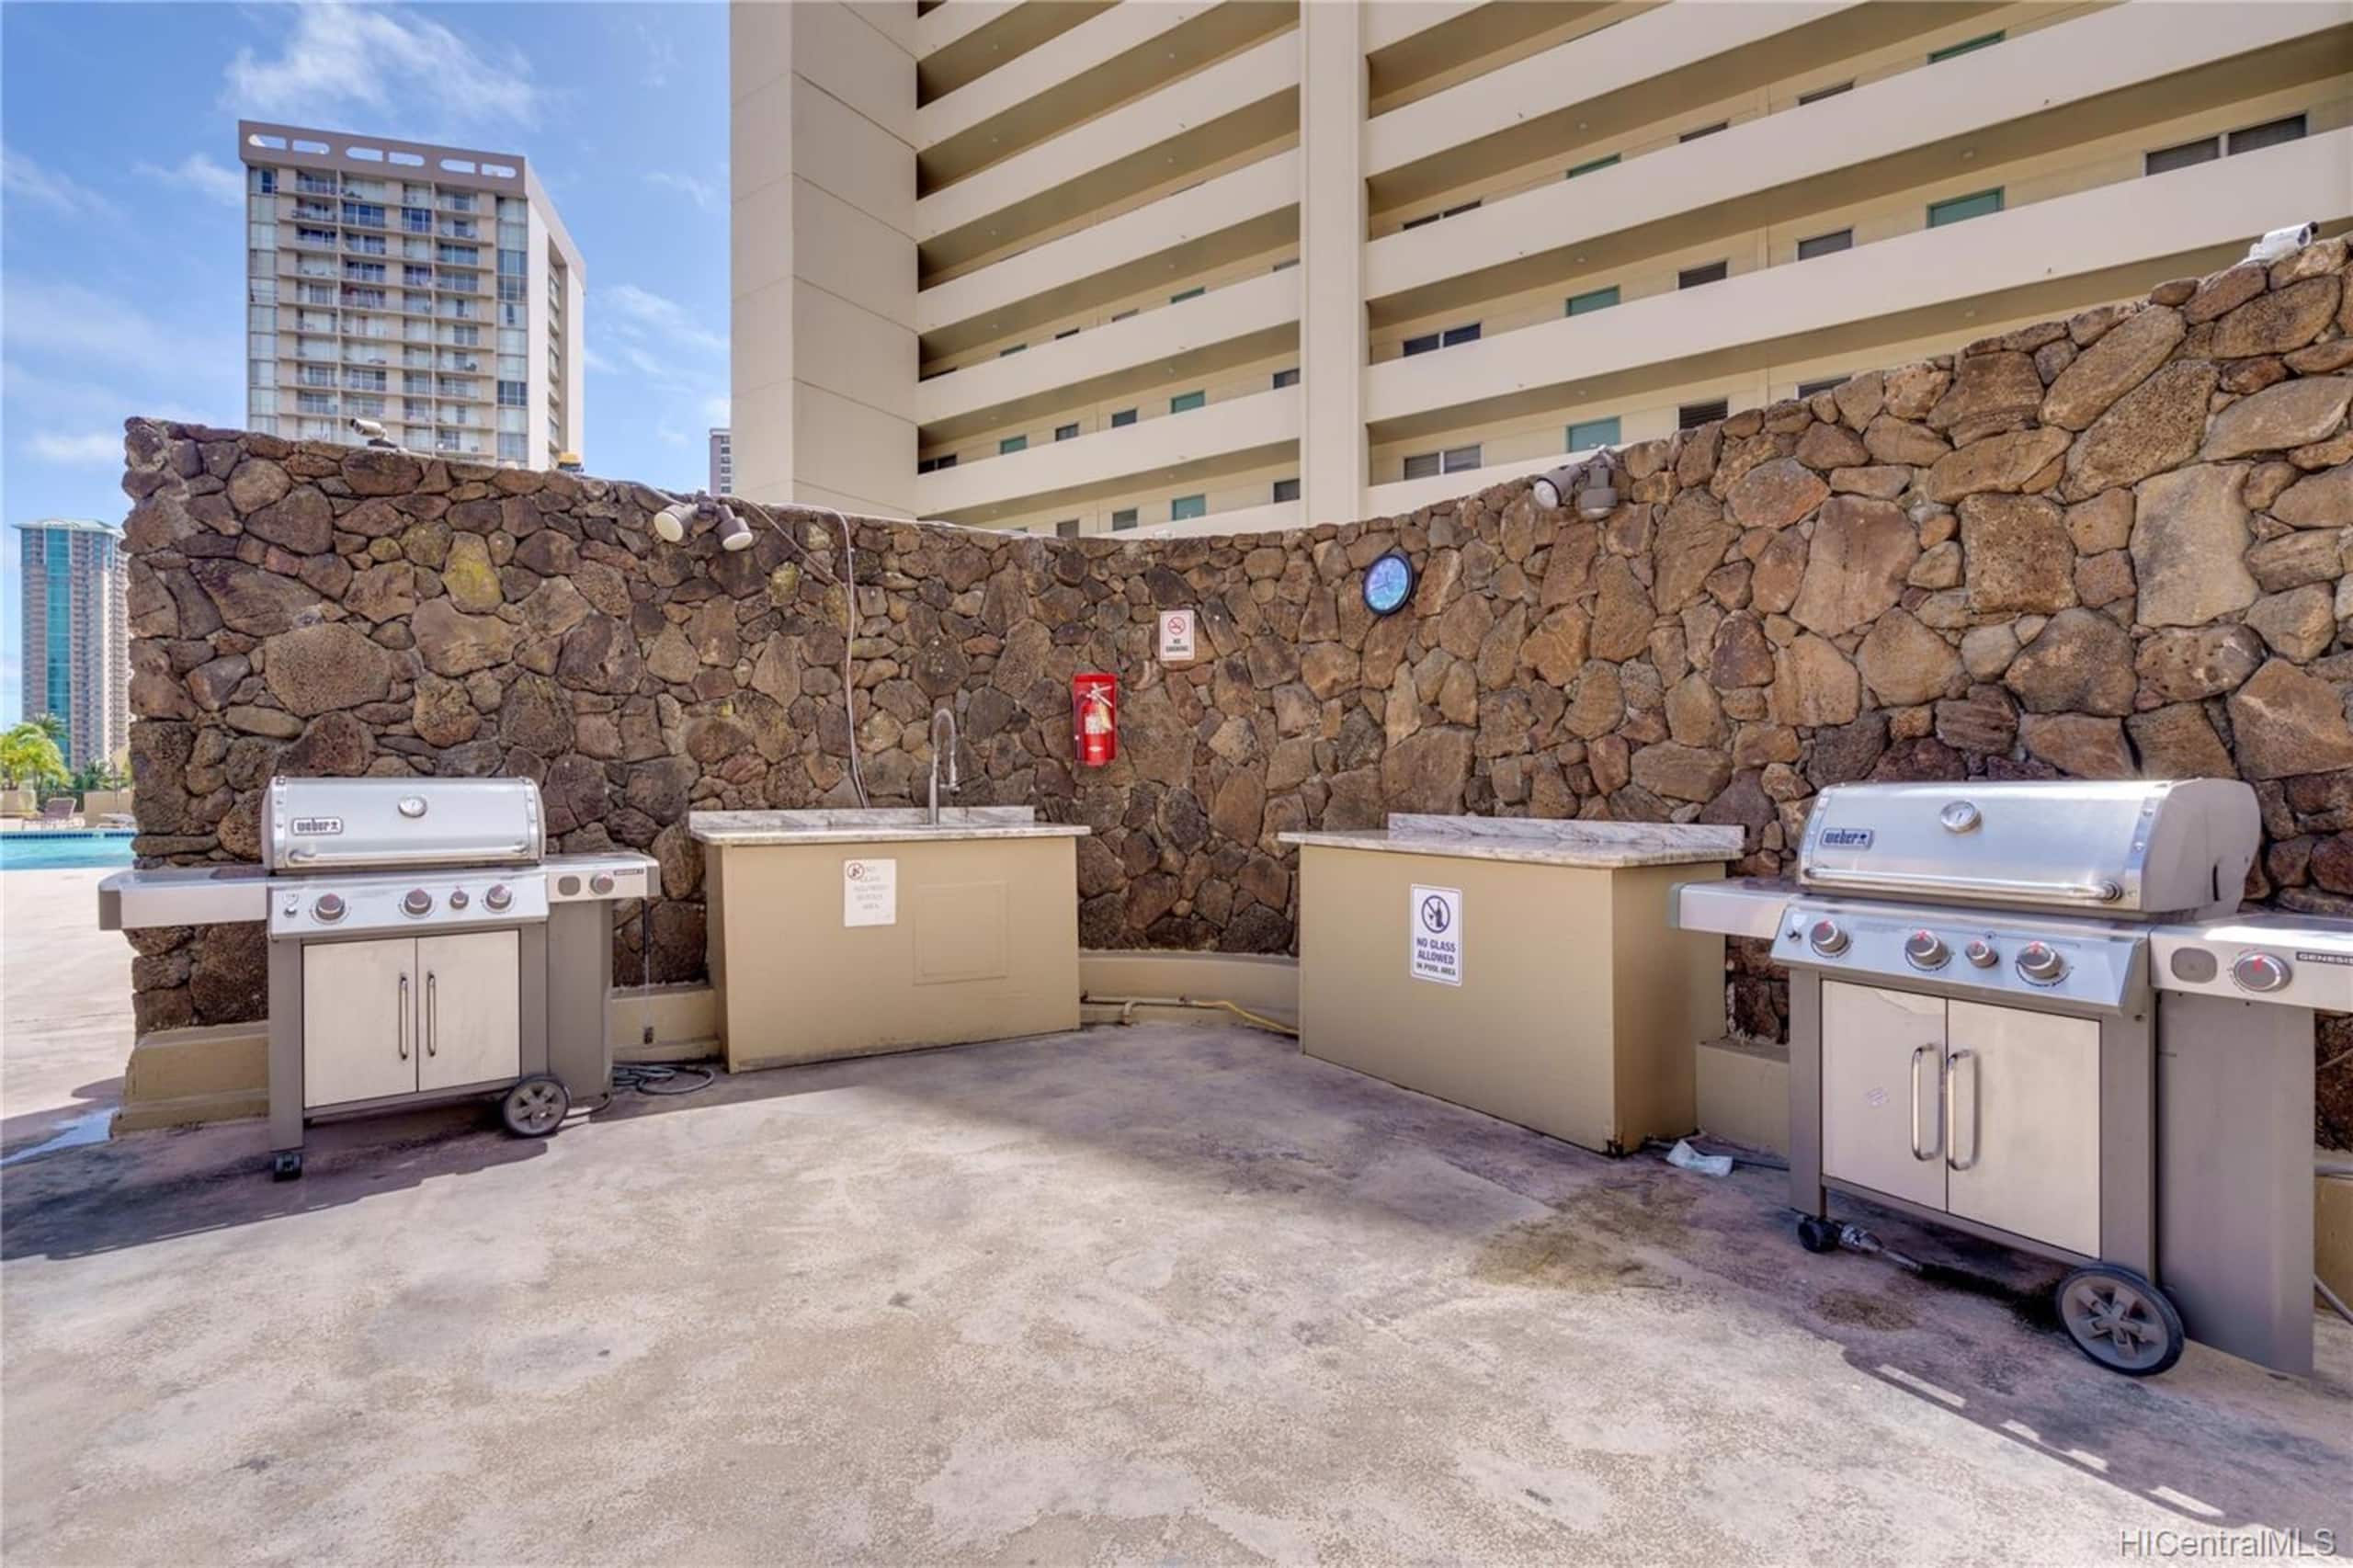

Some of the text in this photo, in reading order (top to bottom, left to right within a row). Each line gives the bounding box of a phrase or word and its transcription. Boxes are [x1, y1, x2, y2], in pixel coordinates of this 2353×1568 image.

[1824, 829, 1859, 844] weber
[1416, 937, 1456, 953] NO GLASS
[1417, 949, 1454, 965] ALLOWED
